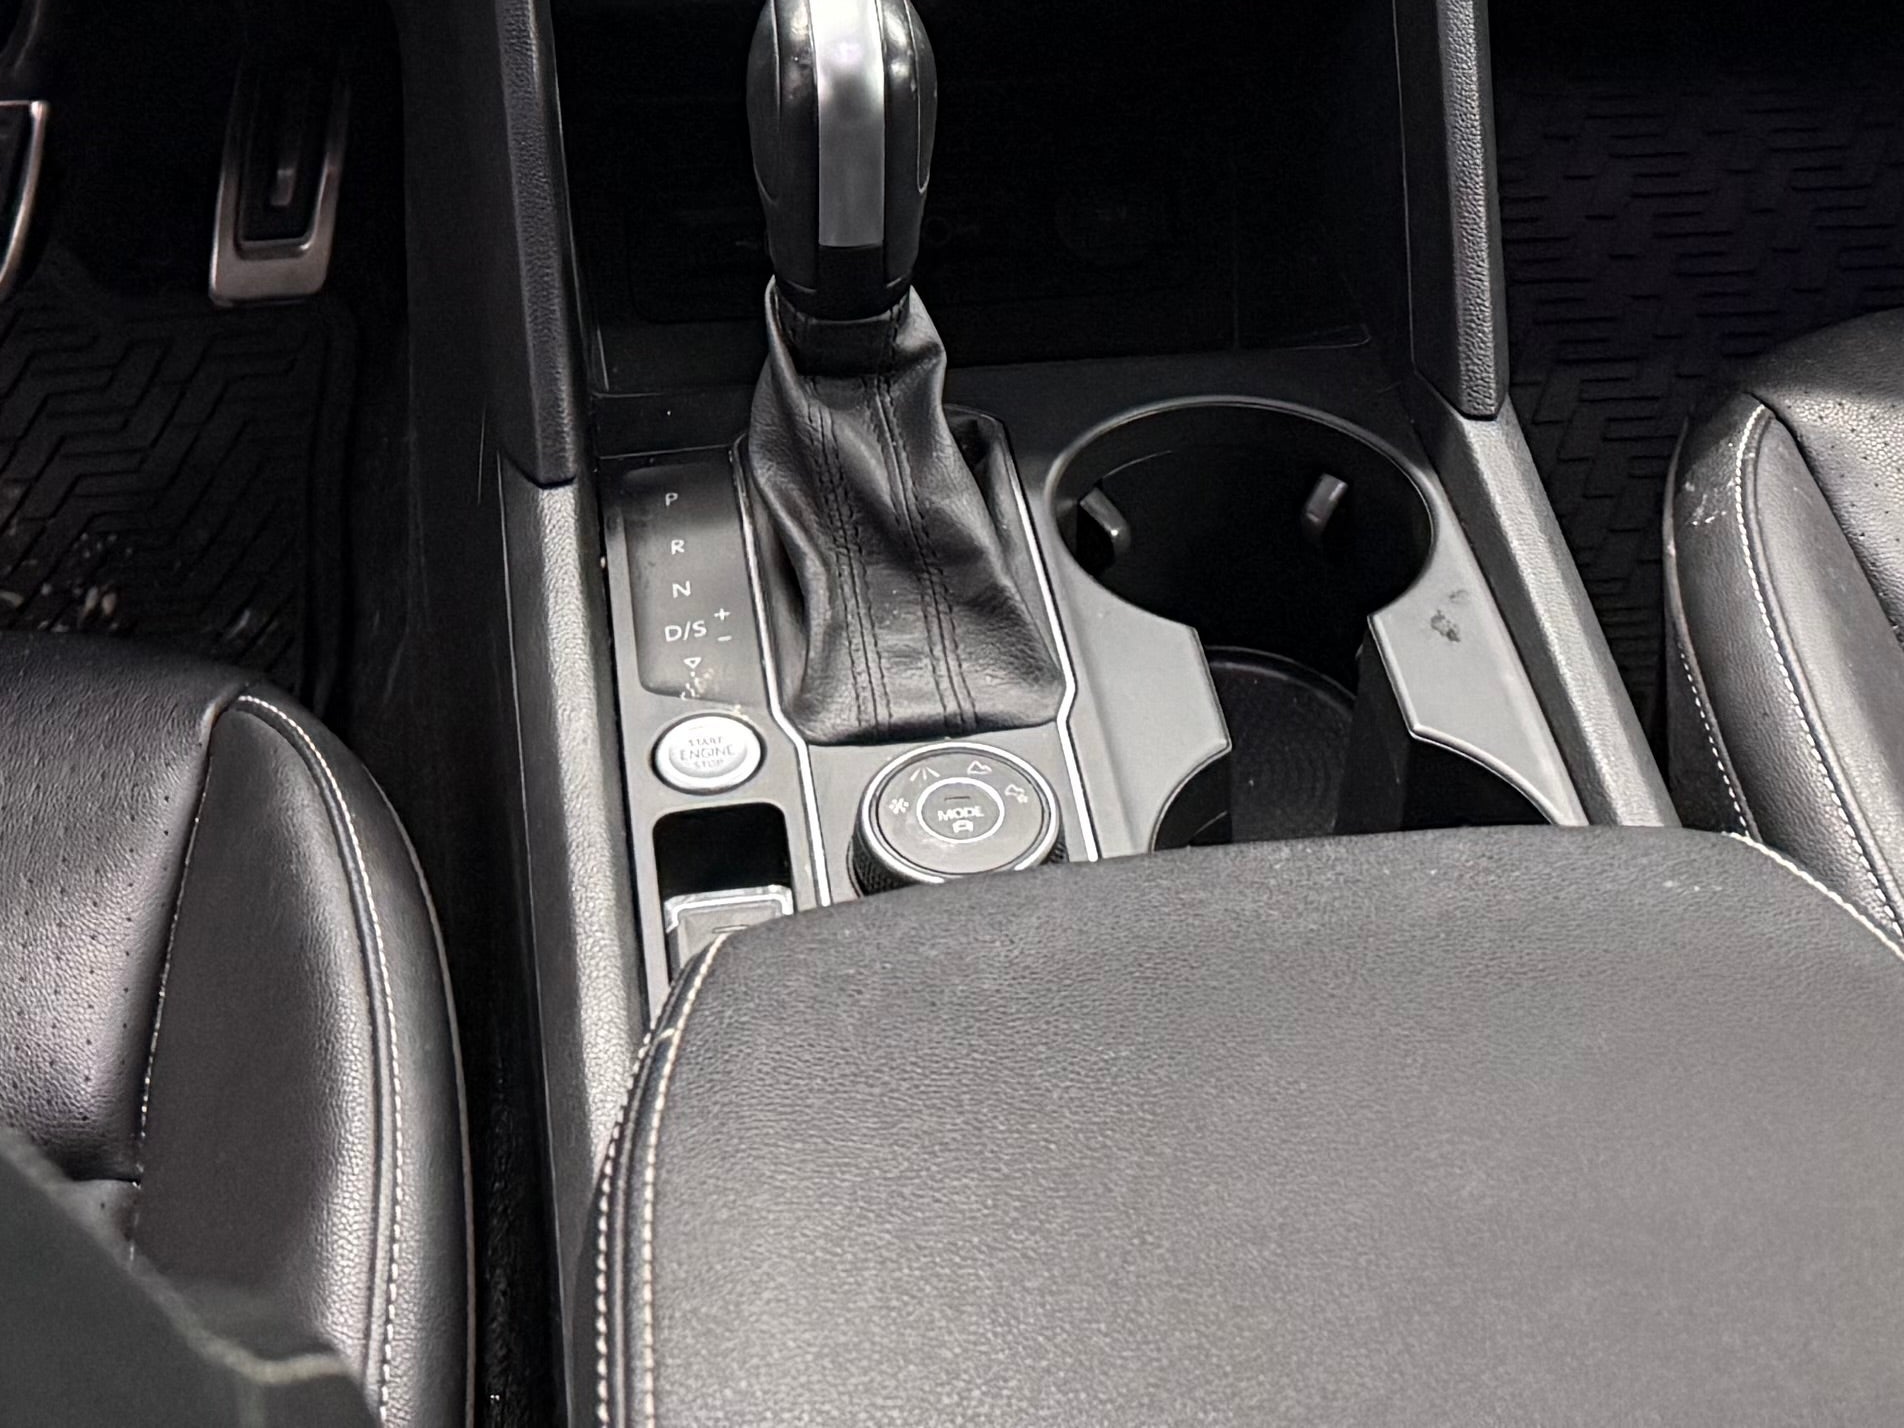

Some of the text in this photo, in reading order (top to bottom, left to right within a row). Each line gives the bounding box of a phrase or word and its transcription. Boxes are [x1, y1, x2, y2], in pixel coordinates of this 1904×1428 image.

[665, 492, 678, 506] P
[671, 539, 685, 555] R
[672, 581, 691, 598] N
[664, 620, 707, 642] D/S
[680, 745, 736, 761] ENGINE
[937, 805, 984, 821] MODE
